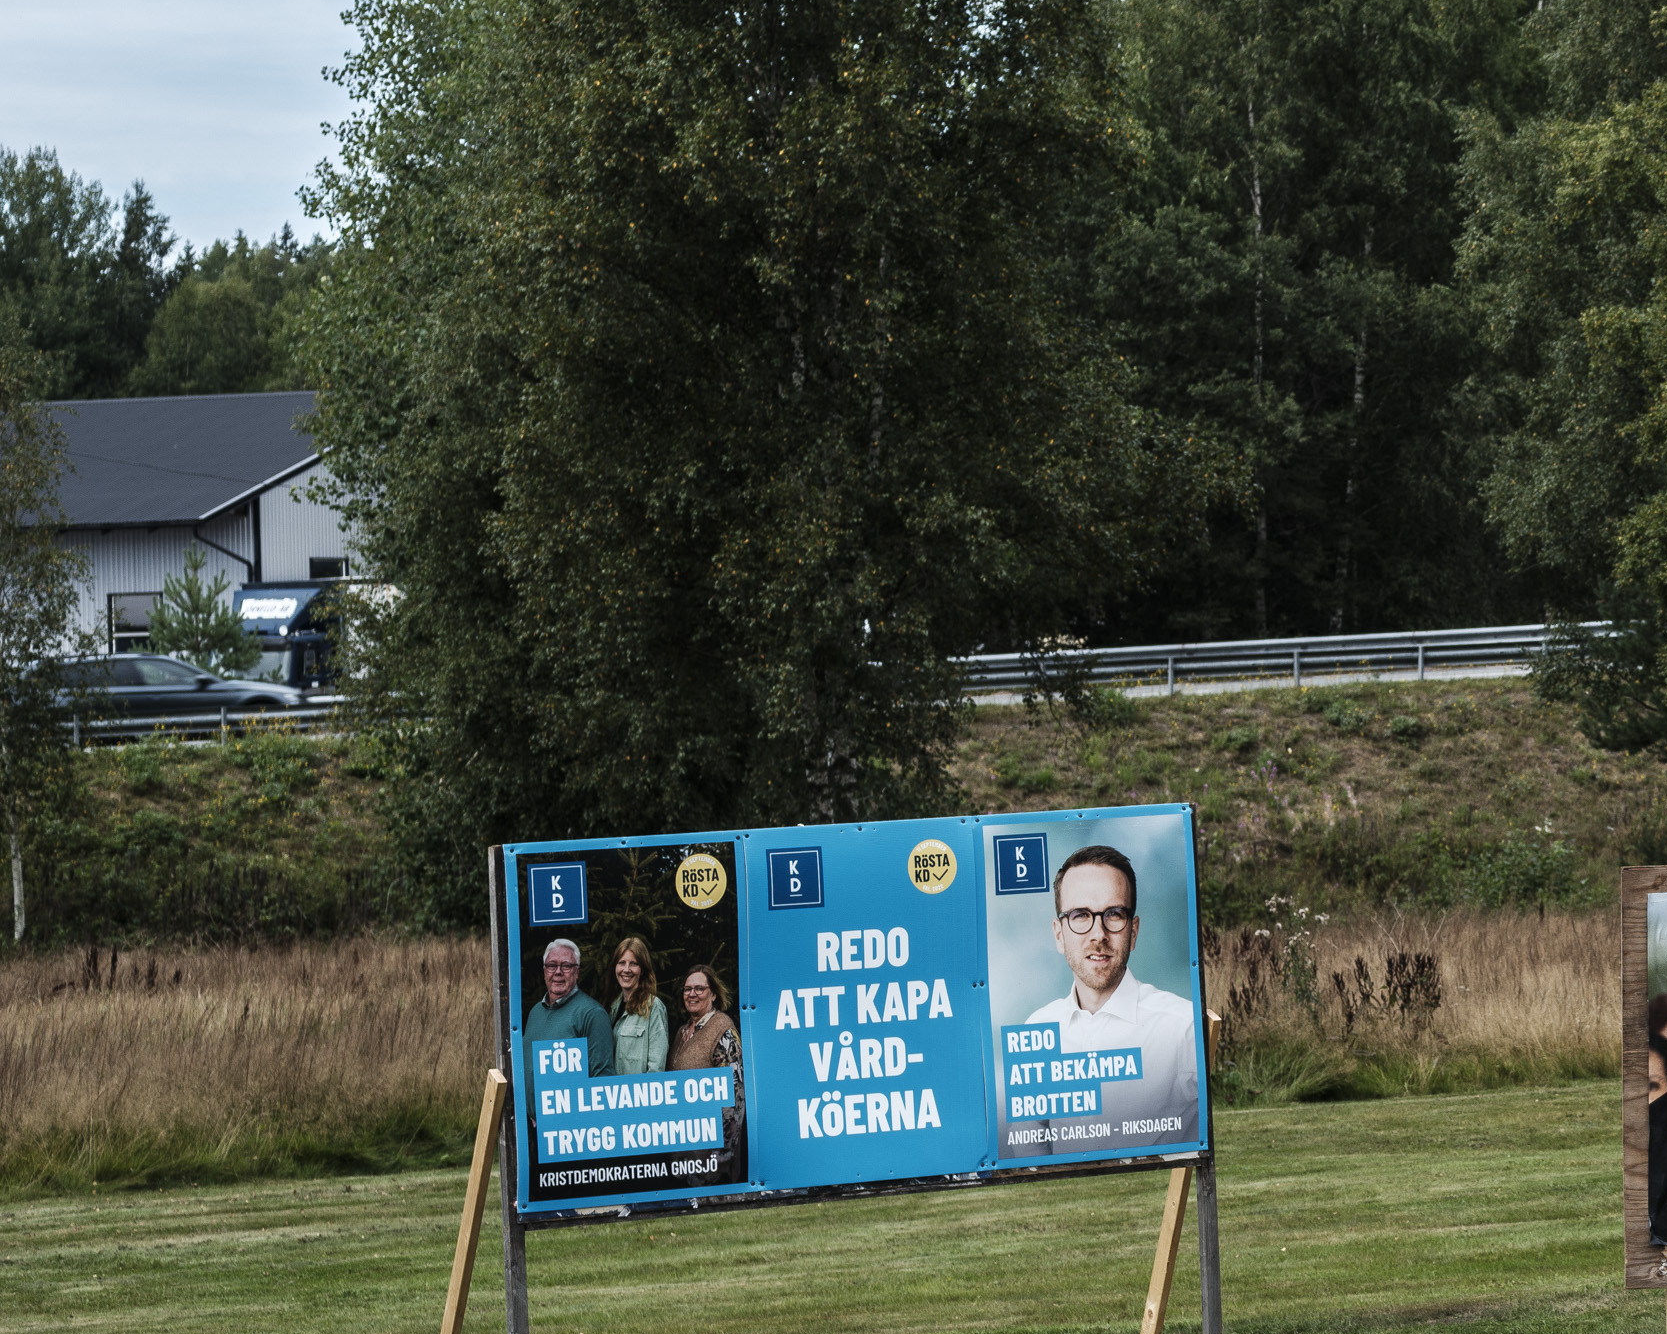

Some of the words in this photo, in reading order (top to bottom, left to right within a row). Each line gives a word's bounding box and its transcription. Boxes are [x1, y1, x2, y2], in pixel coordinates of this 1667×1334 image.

[689, 855, 717, 867] SEPTEMBER
[920, 841, 947, 852] SEPTEMBER
[683, 884, 699, 898] KD
[915, 869, 930, 883] KD
[701, 899, 713, 907] 2022
[817, 926, 909, 972] REDO
[775, 985, 845, 1030] ATT
[856, 978, 954, 1024] KAPA
[809, 1031, 924, 1082] VÅRD-
[1006, 1029, 1055, 1053] REDO
[539, 1041, 583, 1075] FÖR
[1009, 1062, 1045, 1085] ATT
[1050, 1052, 1138, 1082] BEKÄMPA
[541, 1089, 571, 1115] EN
[577, 1080, 678, 1112] LEVANDE
[684, 1076, 729, 1103] OCH
[1011, 1090, 1097, 1117] BROTTEN
[797, 1088, 942, 1139] KÖERNA
[543, 1125, 616, 1156] TRYGG
[622, 1117, 718, 1149] KOMMUN
[1007, 1127, 1058, 1145] ANDREAS
[1061, 1123, 1111, 1140] CARLSON
[1122, 1117, 1182, 1135] RIKSDAGEN
[539, 1162, 669, 1188] KRISTDEMOKRATERNA
[671, 1154, 718, 1181] GNOSJÖ
